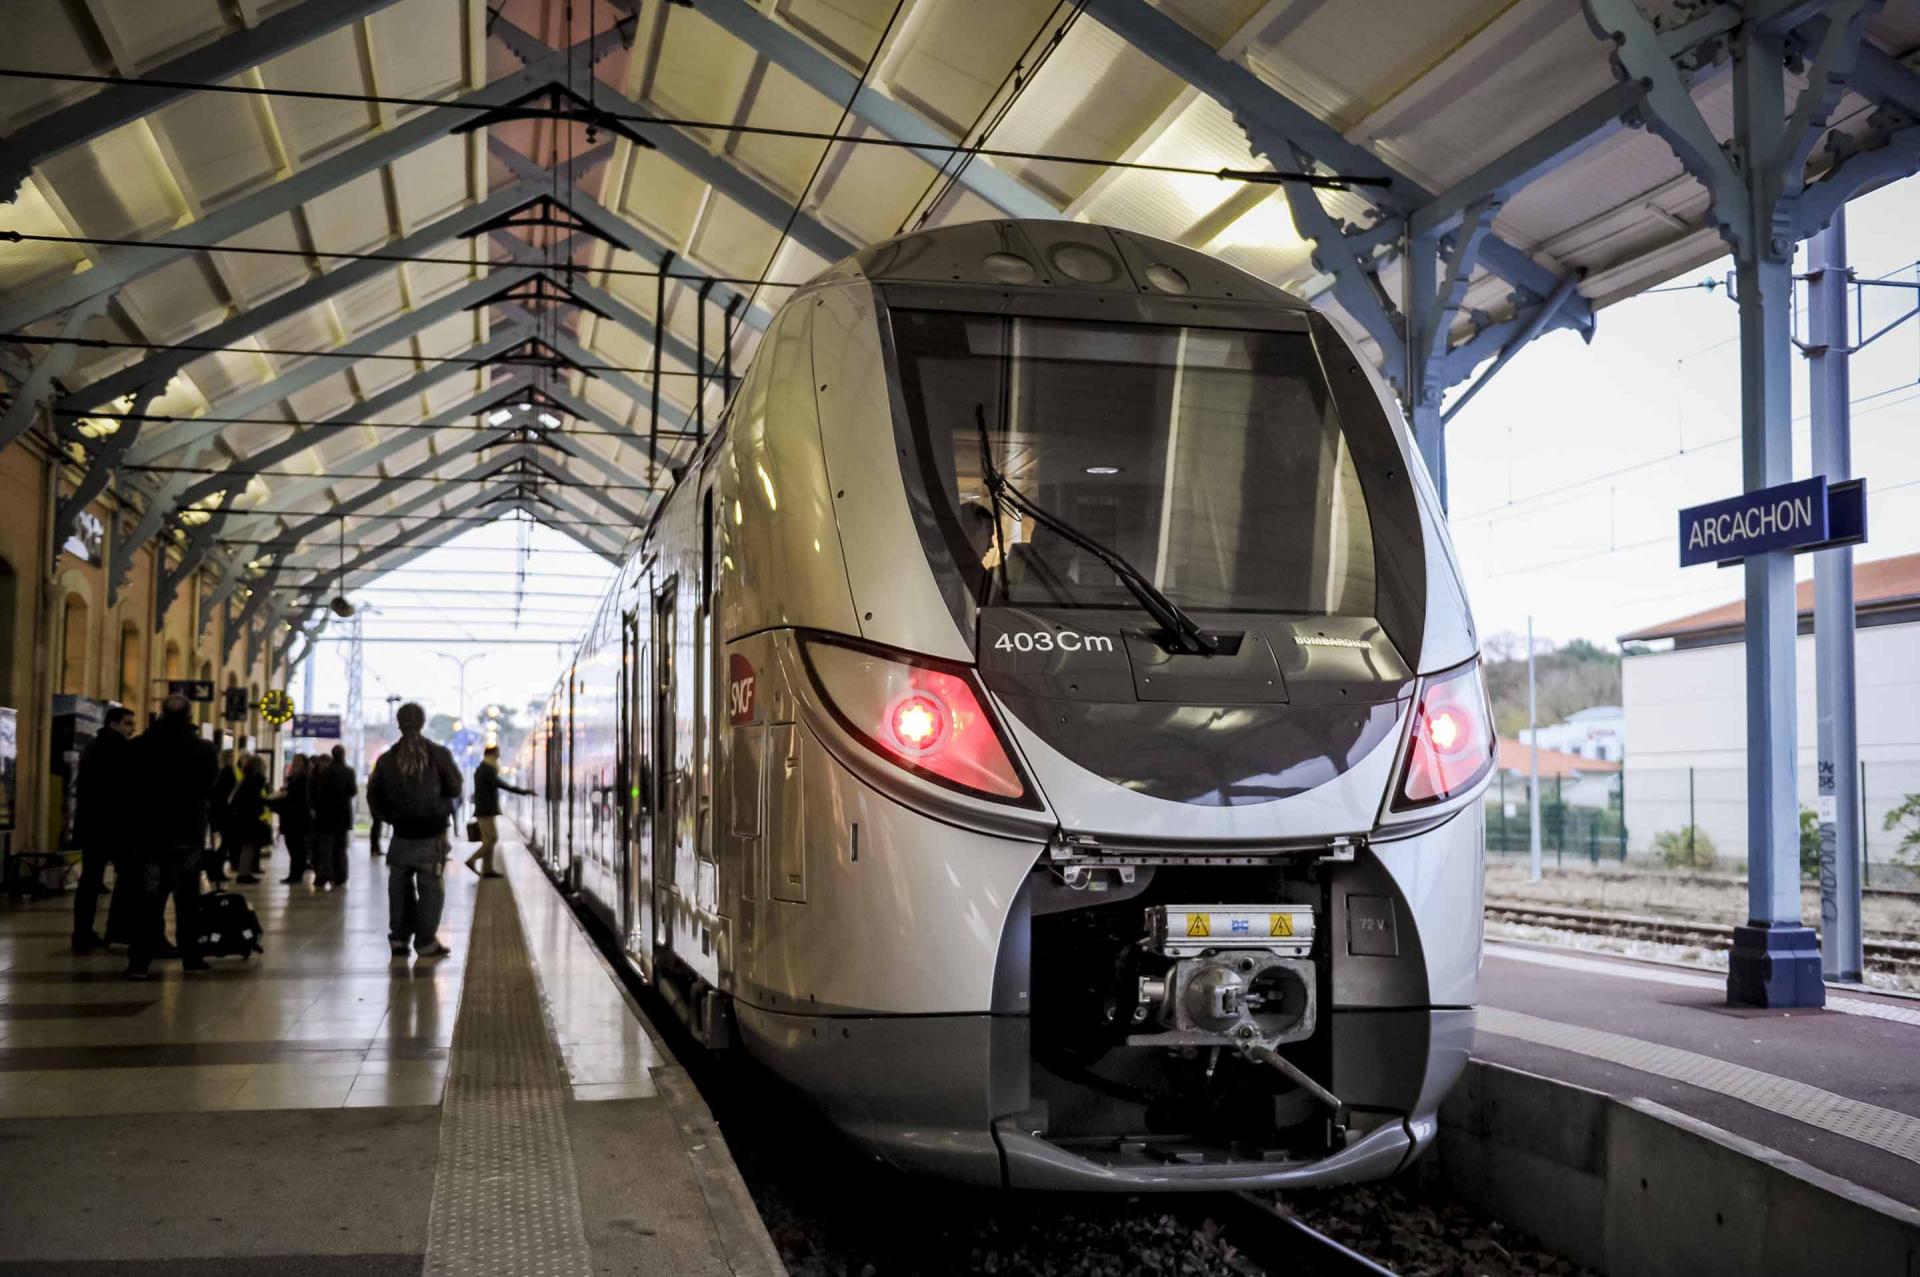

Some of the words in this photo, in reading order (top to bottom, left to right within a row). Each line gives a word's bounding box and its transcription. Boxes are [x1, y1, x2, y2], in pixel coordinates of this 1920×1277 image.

[1688, 496, 1812, 550] ARCACHON
[994, 631, 1113, 652] 403Cm
[1294, 636, 1372, 649] BOMBARDIER
[731, 677, 754, 716] SNCF
[1360, 918, 1374, 930] 72
